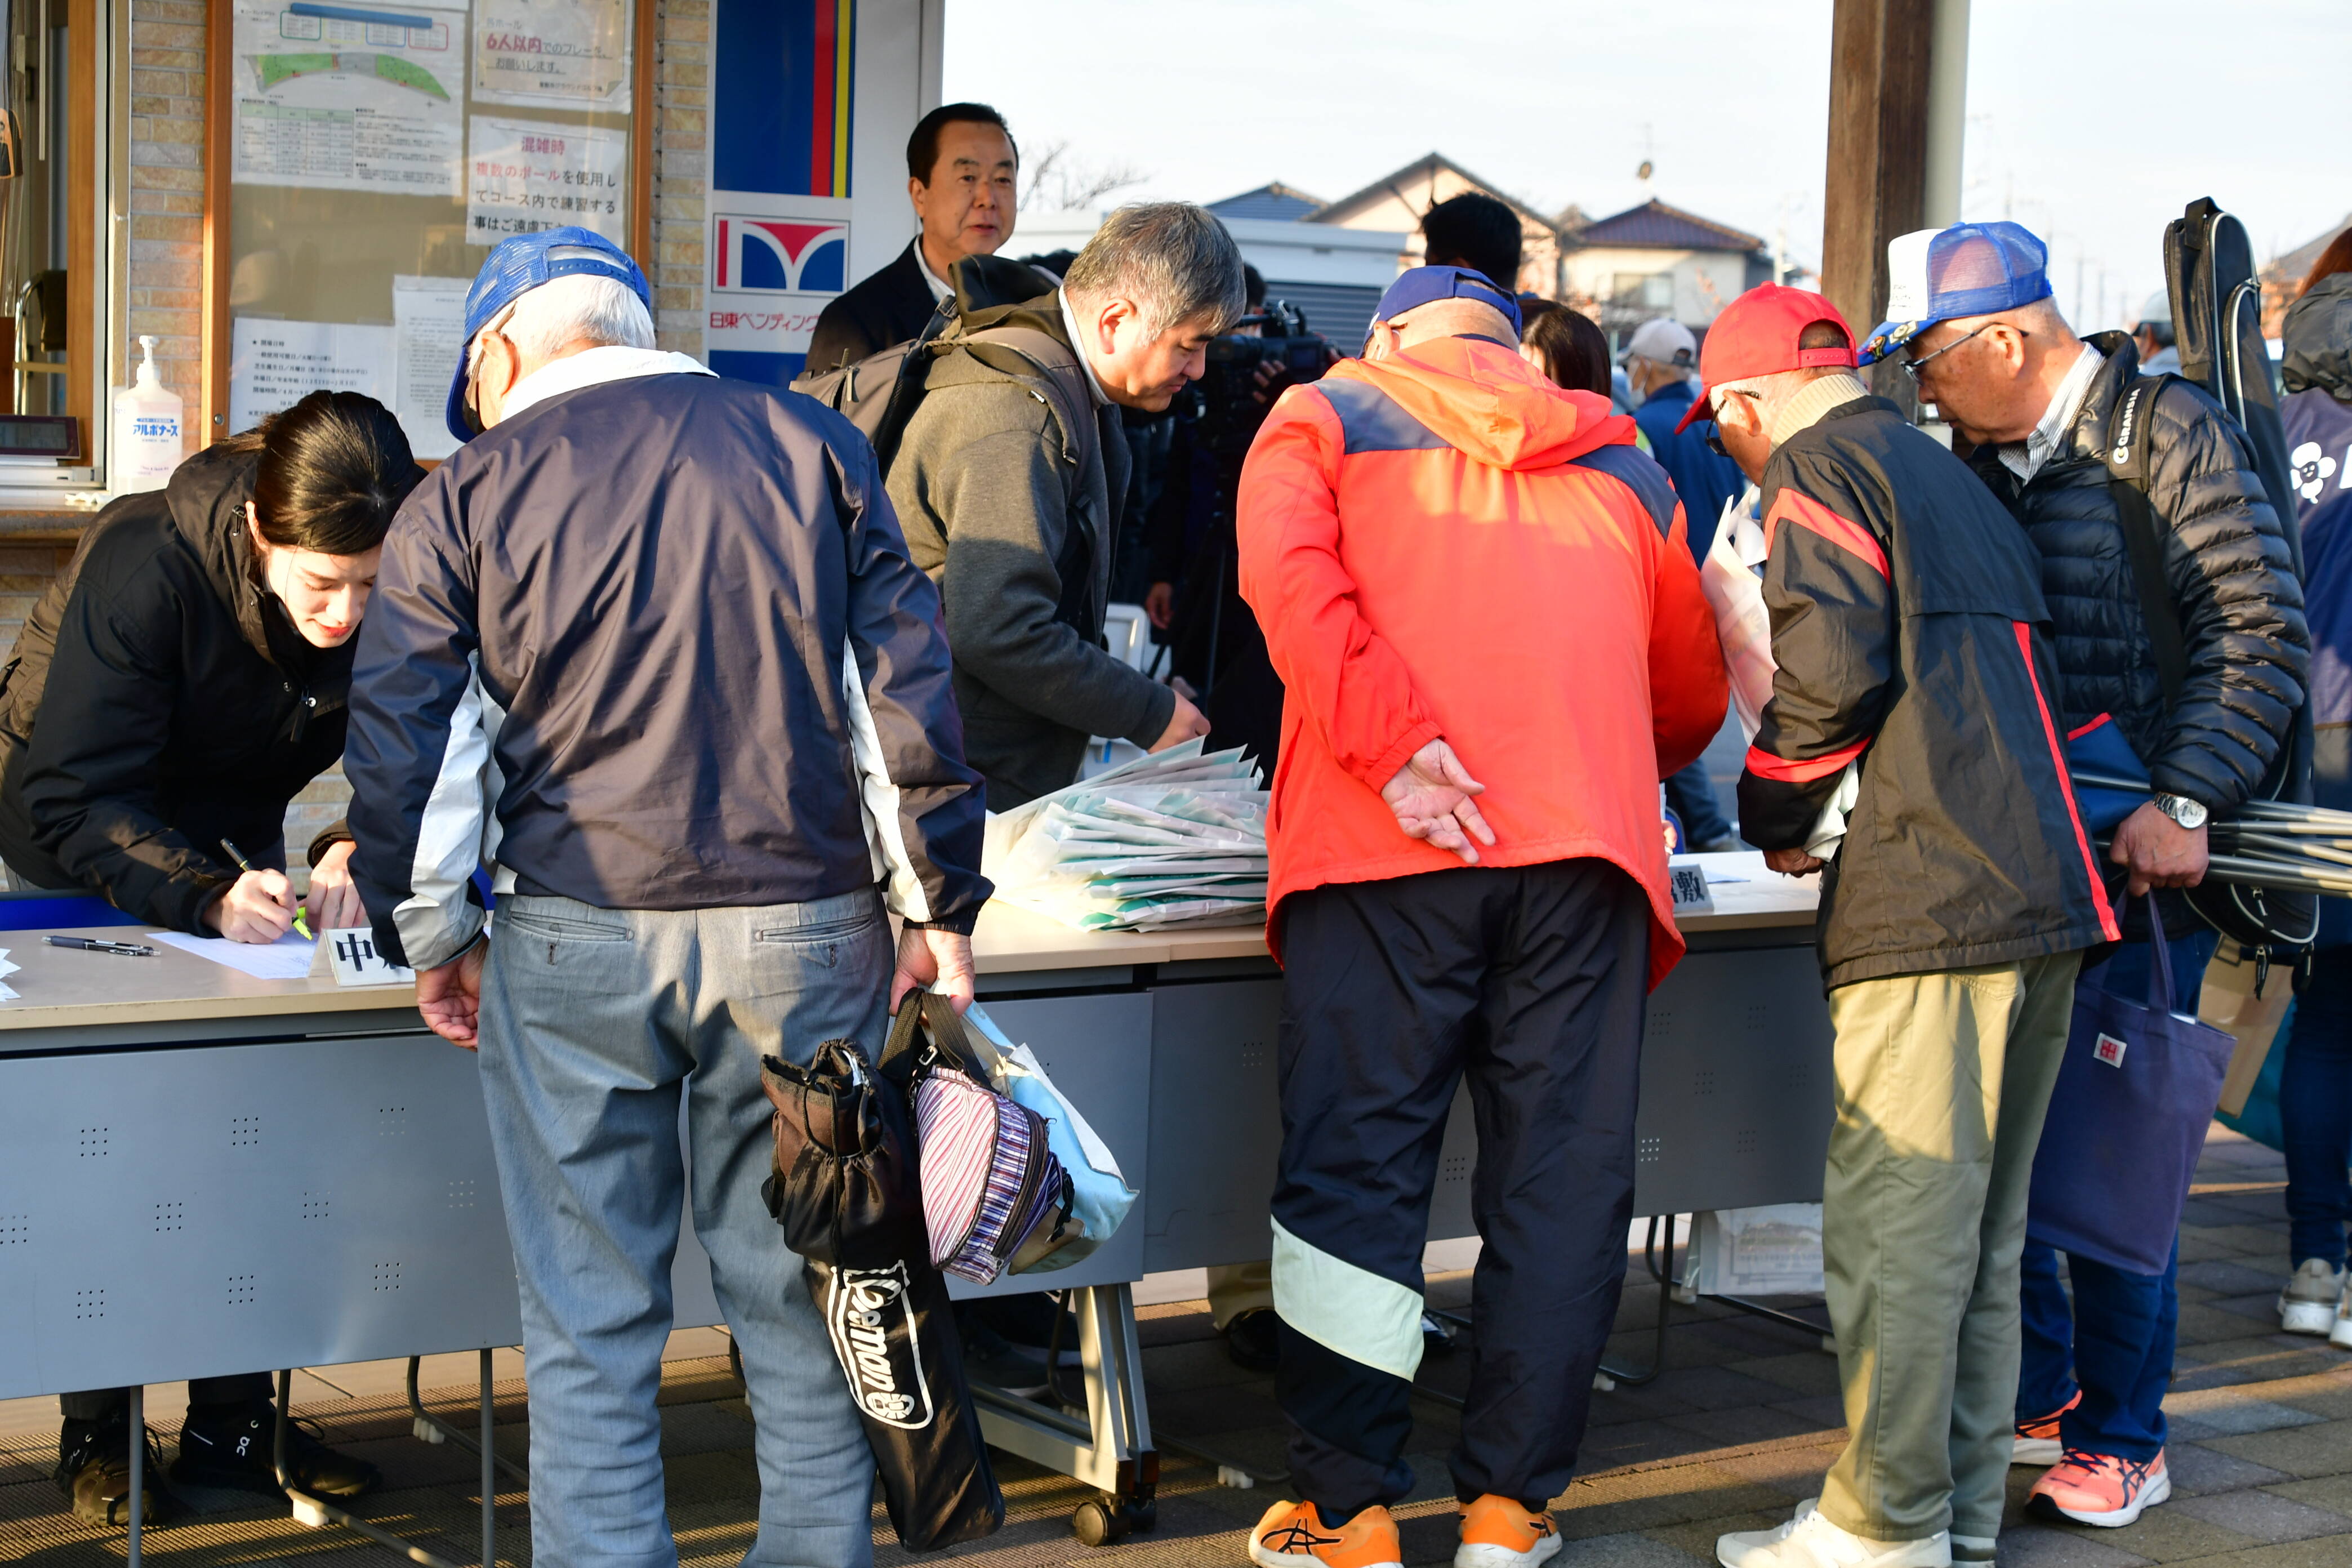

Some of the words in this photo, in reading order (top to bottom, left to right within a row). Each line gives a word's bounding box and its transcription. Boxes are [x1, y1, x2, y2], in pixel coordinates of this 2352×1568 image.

[522, 136, 565, 155] 混雑時
[476, 162, 616, 188] 複数のボールを使用し
[476, 190, 616, 214] てコース内で練習する
[2118, 387, 2141, 446] GRANSIA
[133, 424, 178, 437] アルボナース
